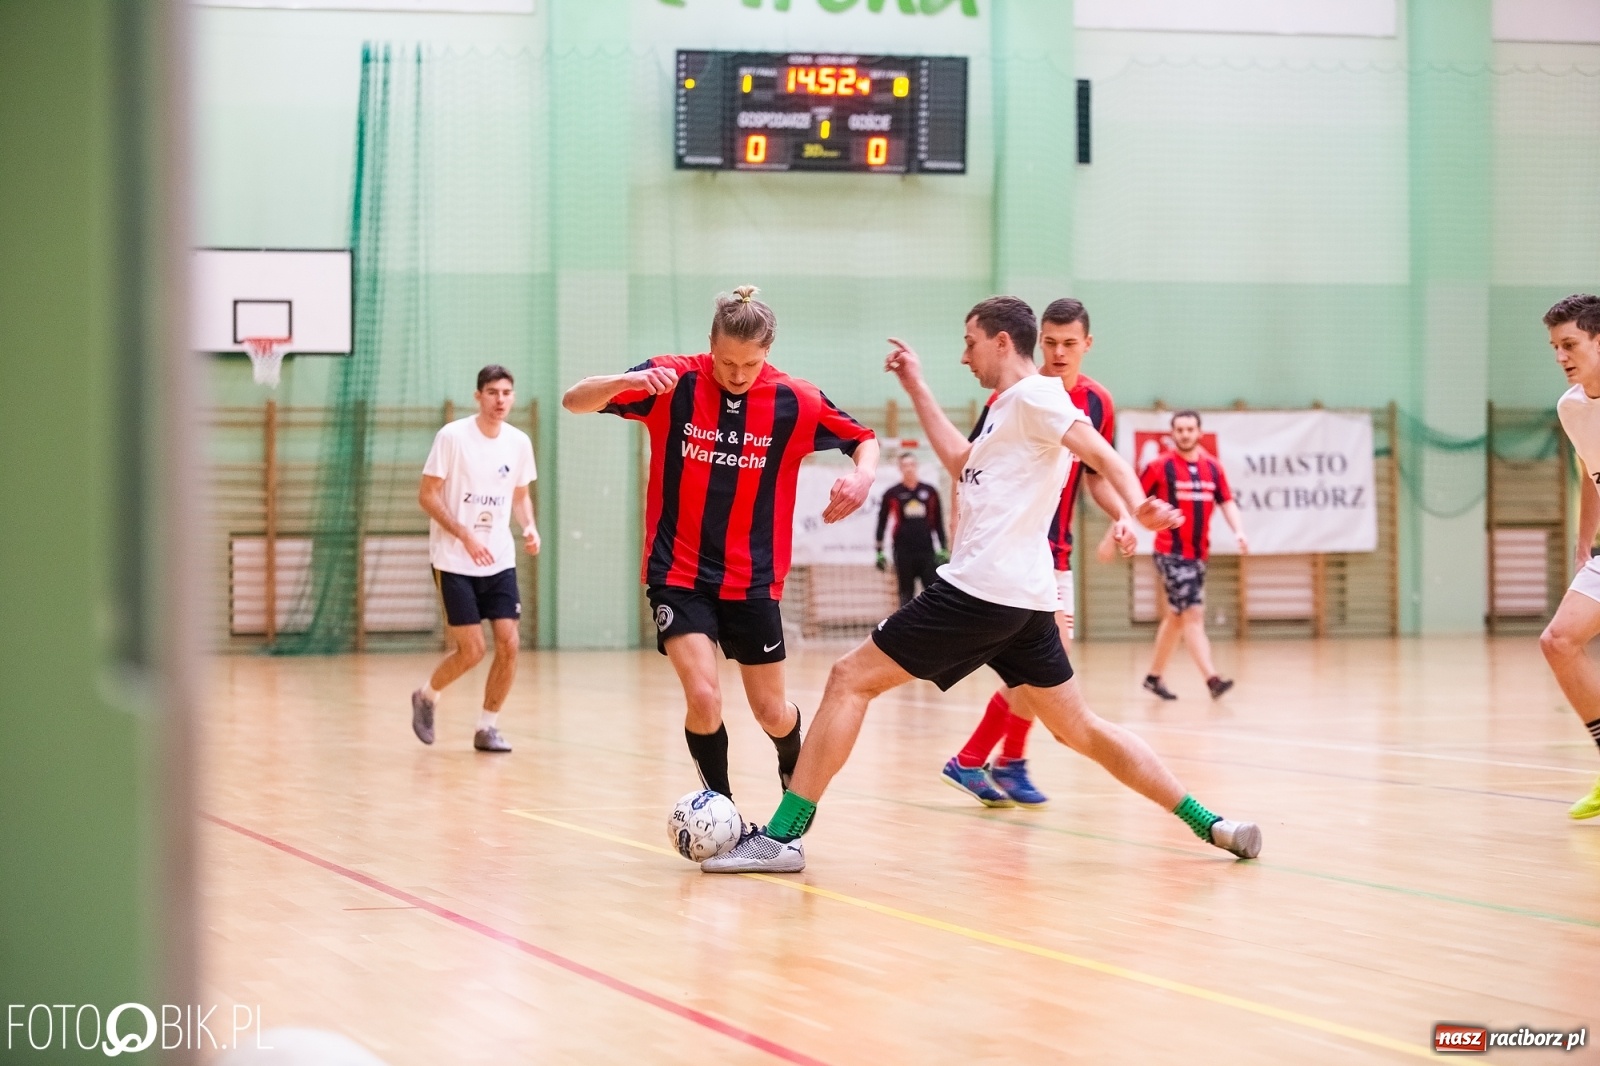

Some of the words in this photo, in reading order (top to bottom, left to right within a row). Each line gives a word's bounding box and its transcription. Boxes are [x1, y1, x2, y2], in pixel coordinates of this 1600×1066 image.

[746, 135, 767, 163] 0
[867, 137, 888, 165] 0
[683, 422, 724, 443] Stuck
[727, 430, 739, 445] &
[743, 432, 773, 447] Putz
[681, 440, 767, 469] Warzecha
[1245, 453, 1347, 477] MIASTO
